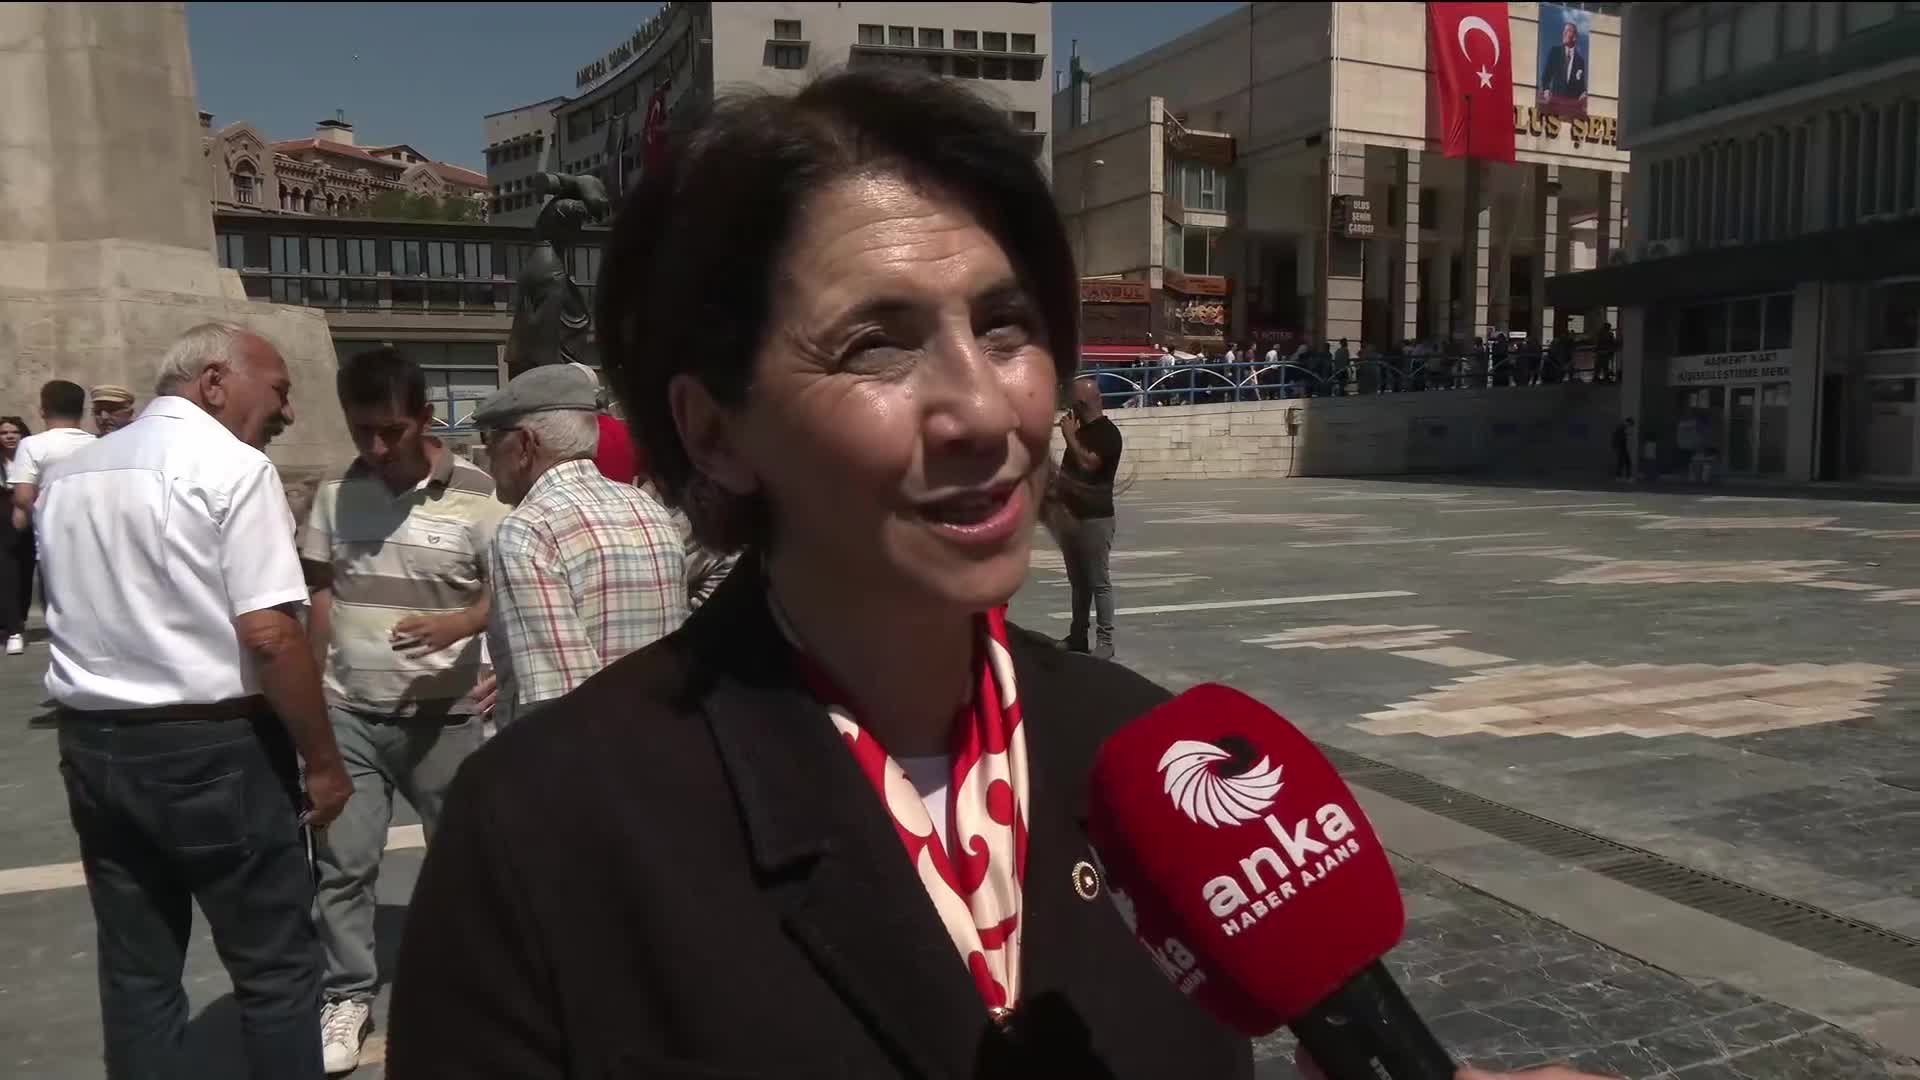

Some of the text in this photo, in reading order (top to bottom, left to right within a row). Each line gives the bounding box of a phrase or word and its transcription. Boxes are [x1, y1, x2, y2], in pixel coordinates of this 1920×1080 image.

[1514, 105, 1561, 139] LUS
[1202, 803, 1355, 917] anka
[1221, 838, 1360, 936] HABER AJANS
